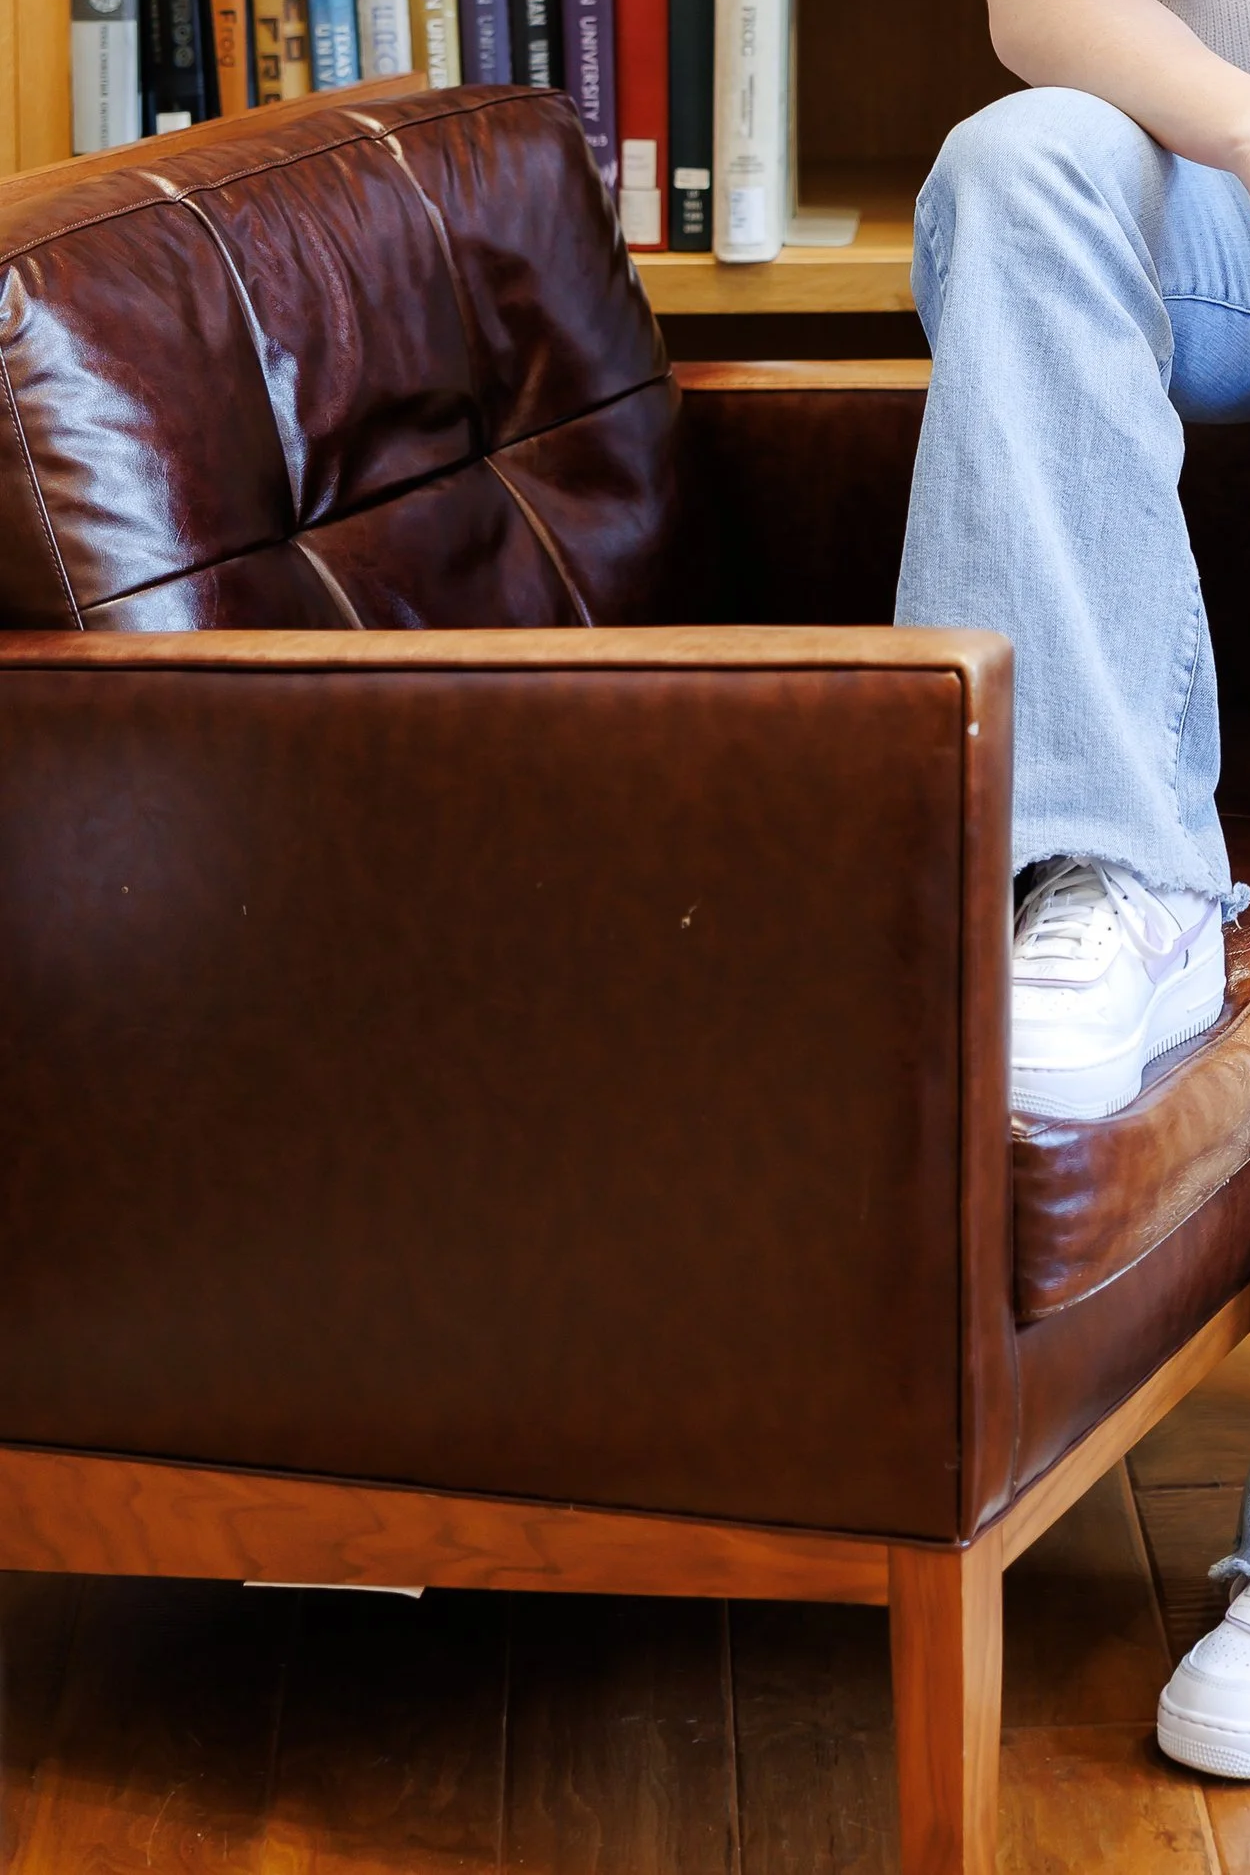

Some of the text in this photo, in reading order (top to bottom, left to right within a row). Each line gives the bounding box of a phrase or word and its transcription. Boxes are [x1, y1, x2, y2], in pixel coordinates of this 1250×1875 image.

[217, 9, 238, 69] Frog
[741, 6, 758, 58] FROG
[578, 15, 602, 122] UNIVERSITY
